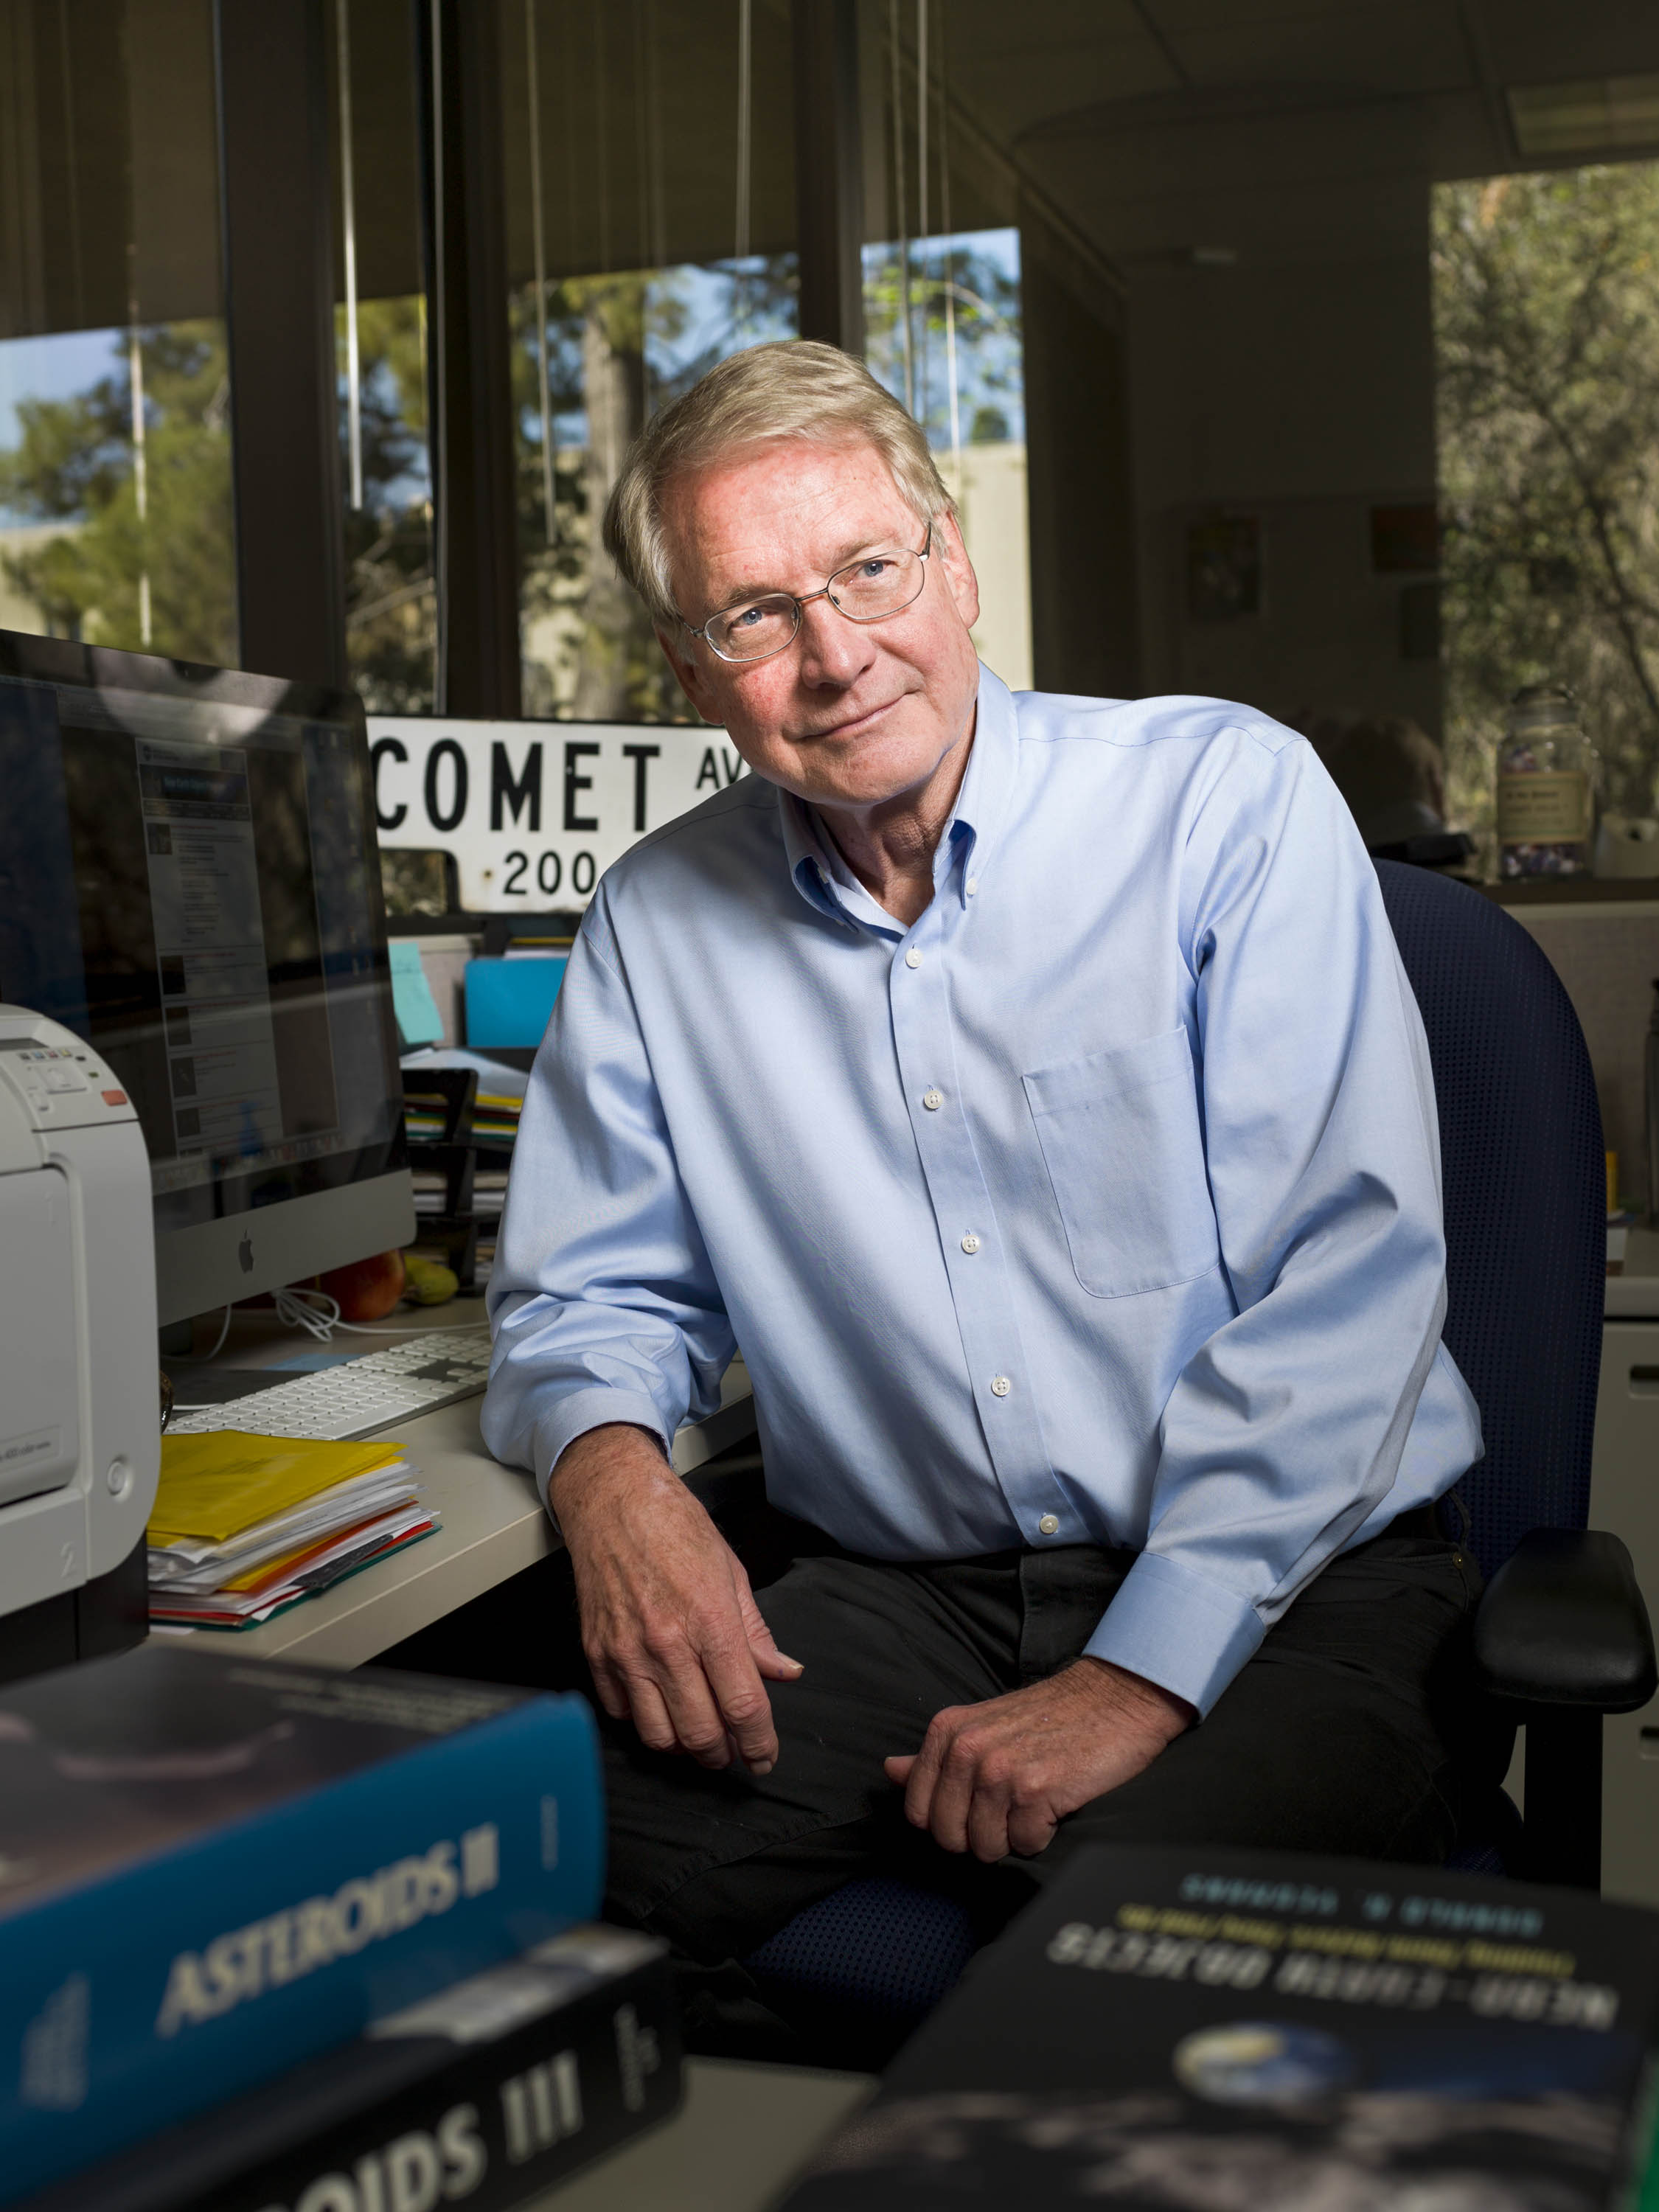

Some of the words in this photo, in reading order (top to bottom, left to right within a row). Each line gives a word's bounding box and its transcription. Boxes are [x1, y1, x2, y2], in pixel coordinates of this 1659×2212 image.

[370, 737, 661, 833] COMET
[695, 746, 748, 790] AV
[504, 850, 596, 895] 200
[157, 1842, 456, 2037] ASTEROIDS
[255, 2101, 488, 2212] OIDS
[500, 2050, 584, 2166] III
